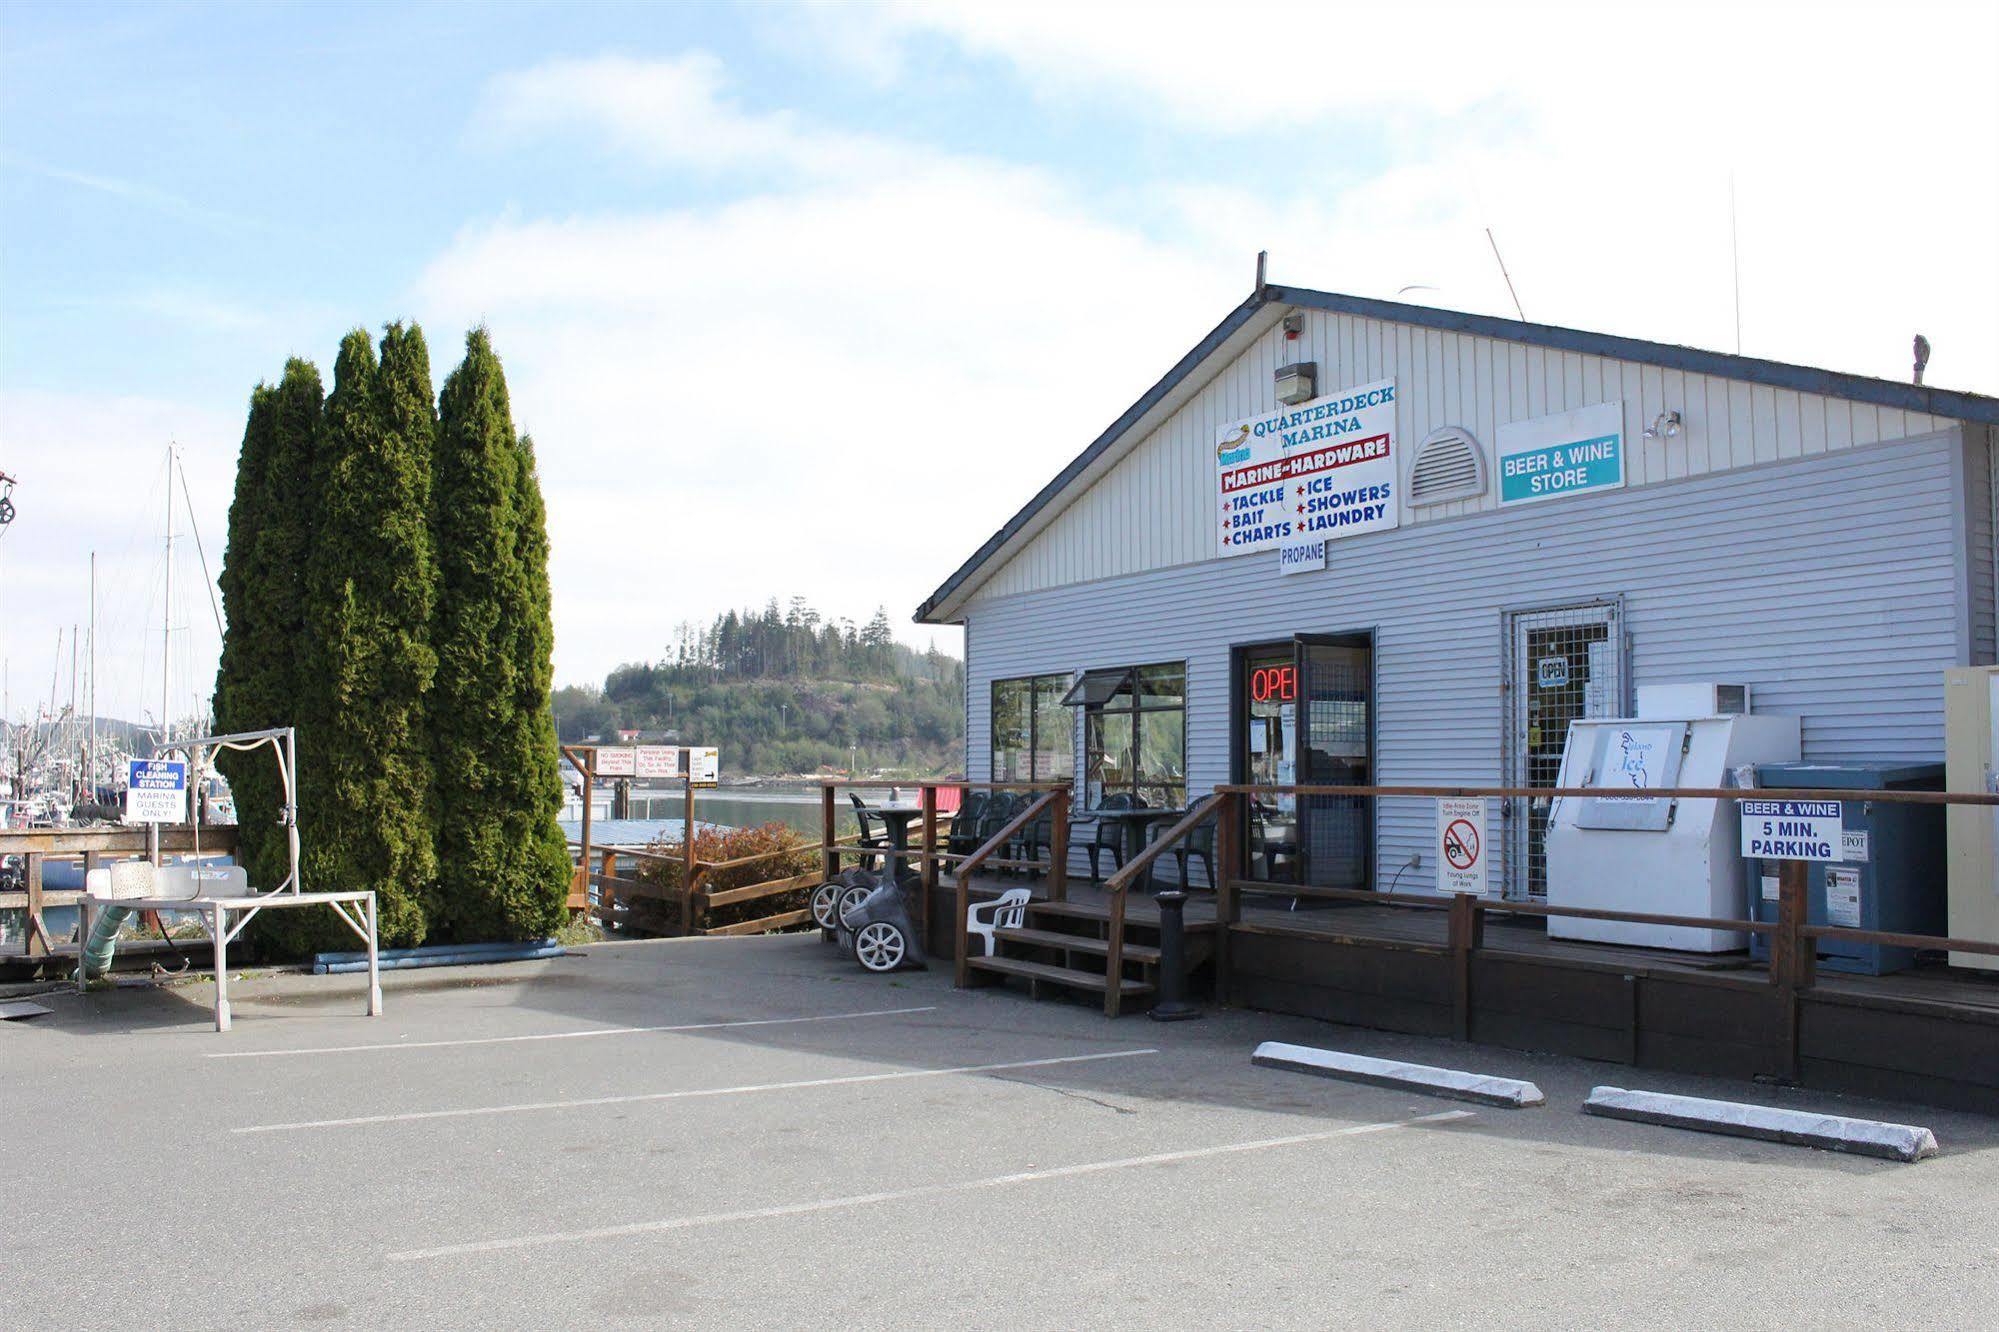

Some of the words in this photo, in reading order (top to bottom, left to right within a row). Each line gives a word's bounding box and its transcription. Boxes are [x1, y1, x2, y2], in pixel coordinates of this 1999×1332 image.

[1254, 386, 1395, 438] QUARTERDECK
[1282, 416, 1362, 448] MARINA
[1224, 438, 1386, 490] MARINE-HARDWARE
[1505, 454, 1548, 477] BEER
[1553, 450, 1564, 468] &
[1568, 440, 1614, 465] WINE
[1307, 476, 1333, 495] ICE
[1530, 467, 1587, 492] STORE
[1232, 486, 1284, 511] TACKLE
[1307, 483, 1390, 513] SHOWERS
[1232, 509, 1264, 529] BAIT
[1308, 503, 1386, 532] LAUNDRY
[1232, 521, 1291, 546] CHARTS
[1281, 543, 1323, 565] PROPANE
[1542, 662, 1565, 679] OPEN
[135, 771, 179, 780] CLEANING
[148, 762, 167, 771] FISH
[139, 780, 176, 788] STATION
[137, 792, 176, 800] MARINA
[1744, 802, 1780, 814] BEER
[1784, 803, 1794, 815] &
[1798, 803, 1837, 816] WINE
[1763, 821, 1772, 836] 5
[1778, 821, 1817, 837] MIN.
[1751, 839, 1831, 857] PARKING
